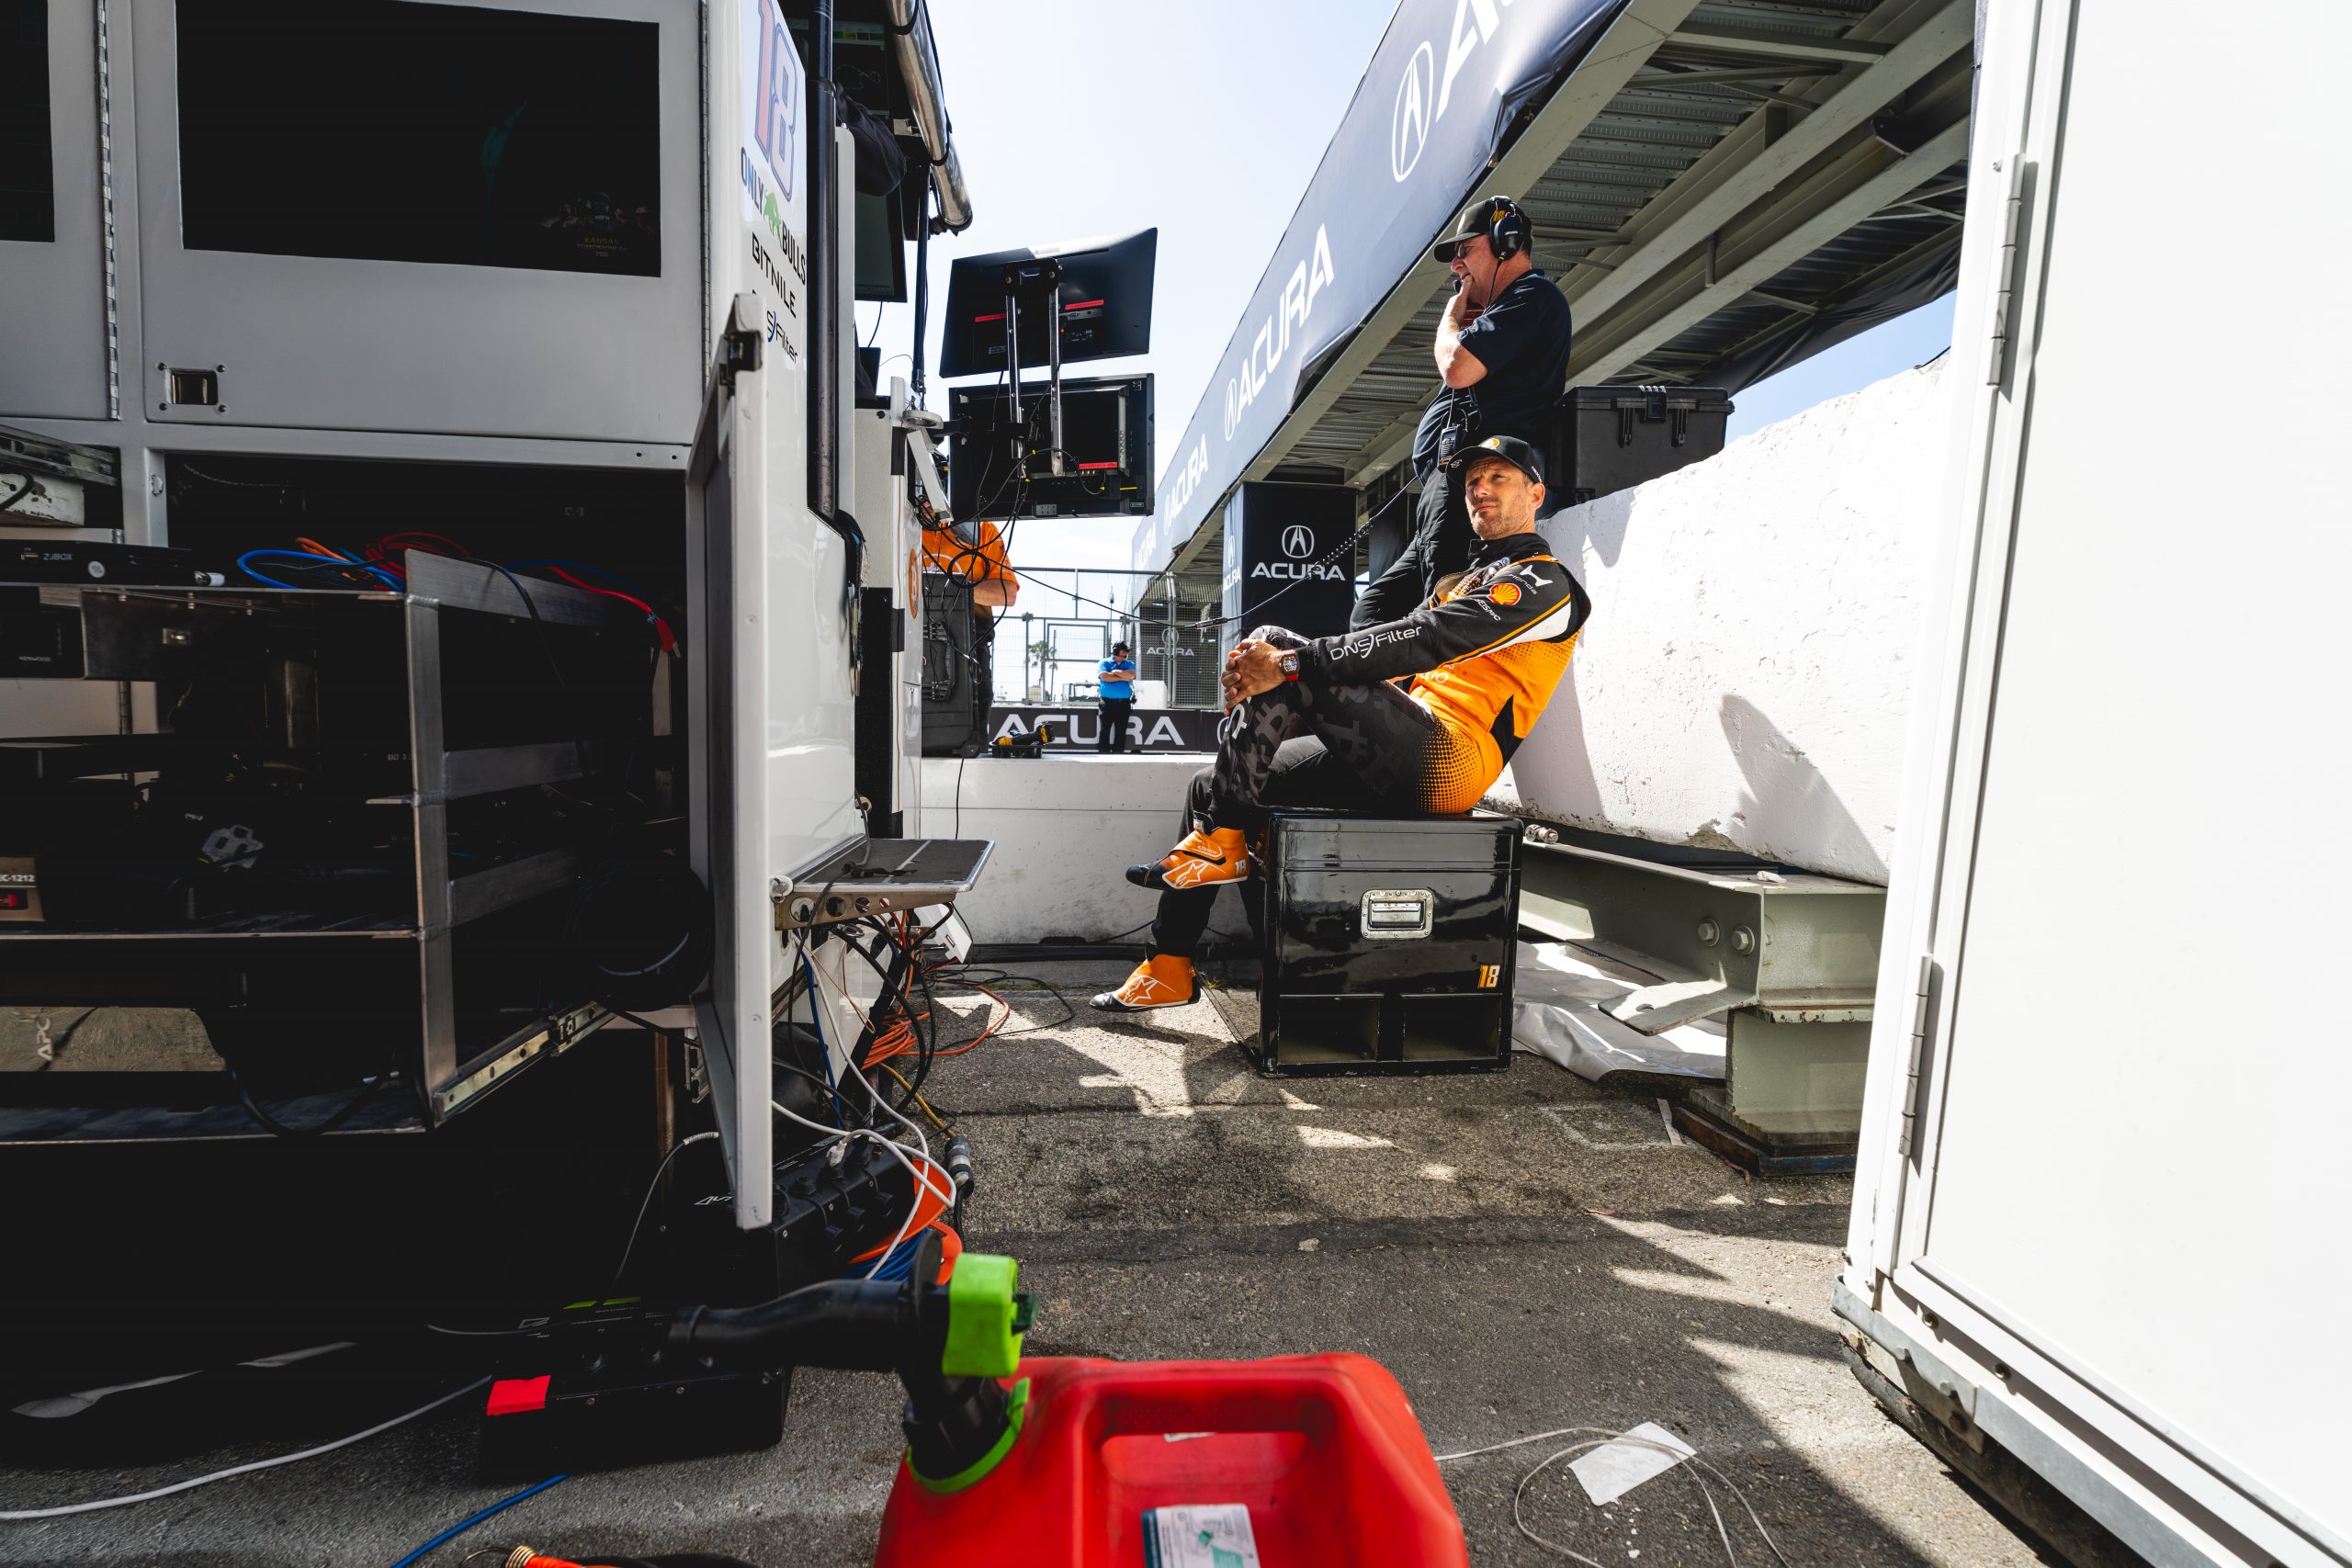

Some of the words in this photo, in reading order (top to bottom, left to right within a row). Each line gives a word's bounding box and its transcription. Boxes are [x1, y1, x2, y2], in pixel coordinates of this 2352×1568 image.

[741, 146, 764, 215] ONLY
[782, 220, 806, 286] BULLS
[752, 231, 797, 319] BITNILE
[1237, 222, 1335, 424] ACURA
[1168, 434, 1208, 525] ACURA
[1250, 561, 1346, 581] ACURA
[1329, 626, 1422, 660] DNSFilter
[1234, 860, 1247, 876] 18
[1477, 964, 1500, 988] 18
[36, 1016, 52, 1062] APC
